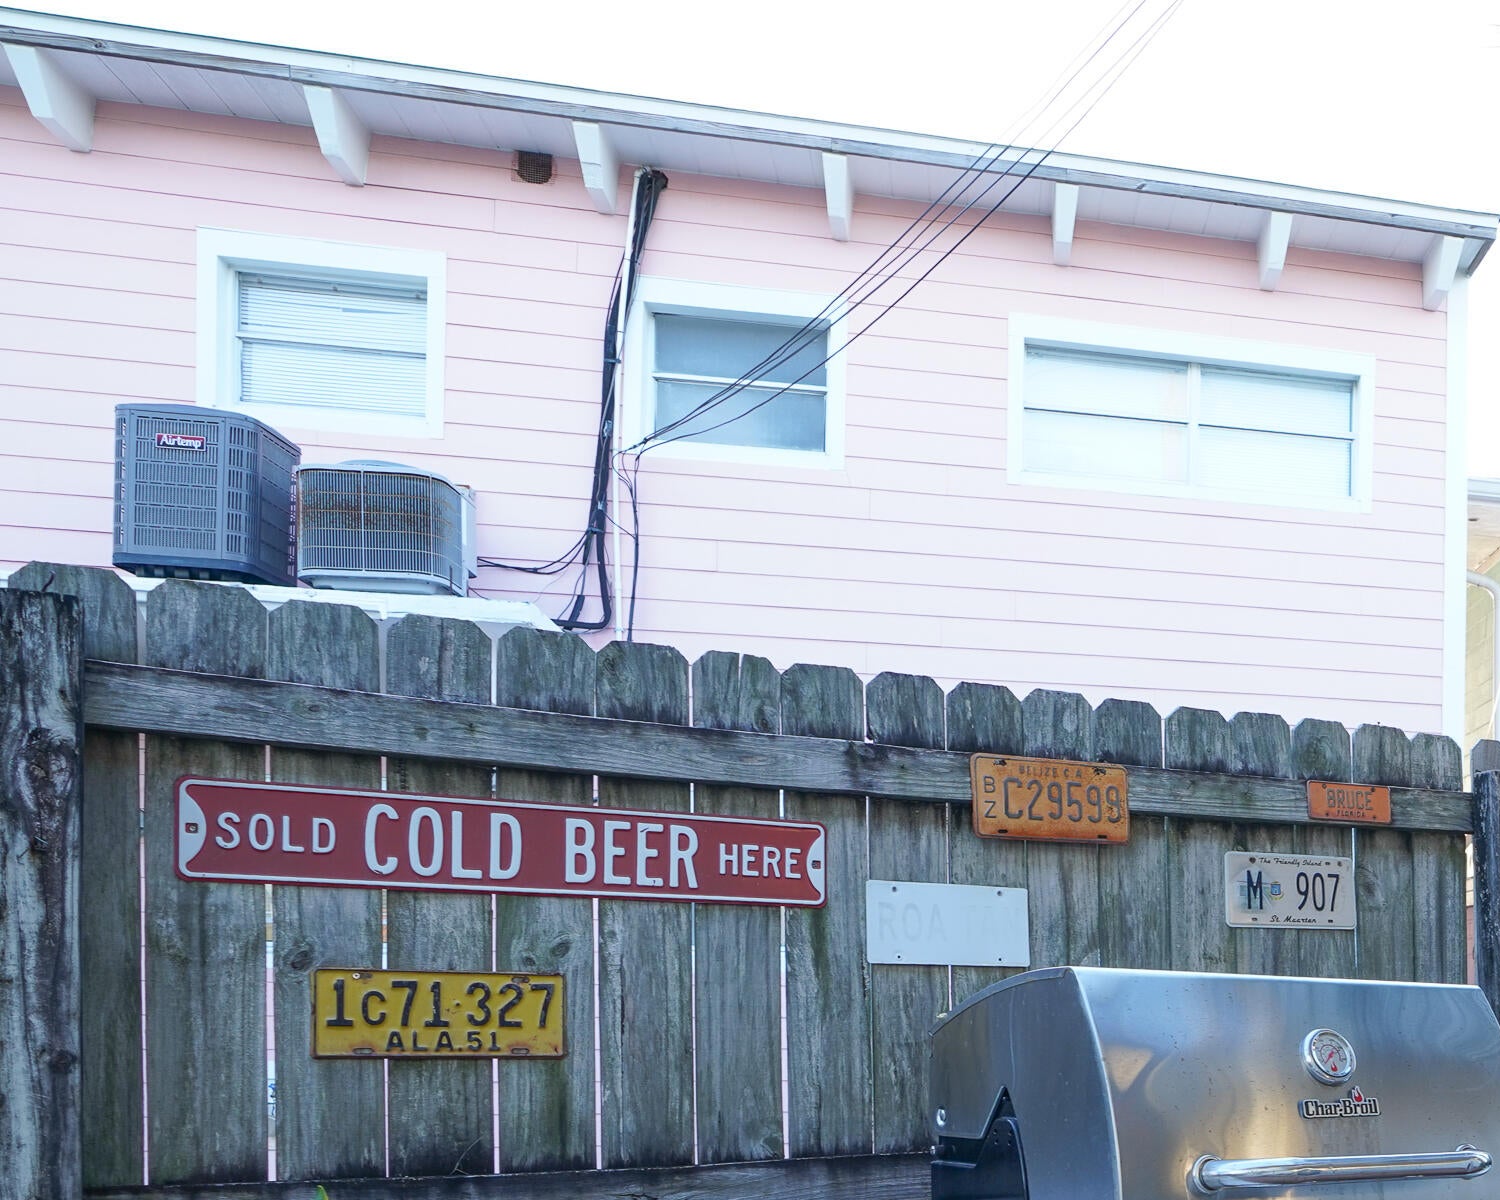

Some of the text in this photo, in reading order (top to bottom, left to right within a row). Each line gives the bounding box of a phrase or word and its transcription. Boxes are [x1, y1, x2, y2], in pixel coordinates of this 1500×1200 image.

[160, 435, 201, 449] Airtemp
[1003, 776, 1121, 823] C29599
[1327, 788, 1374, 811] BRUCE
[1336, 809, 1366, 817] FLORIDA
[215, 803, 802, 889] SOLD COLD BEER HERE
[1246, 870, 1340, 912] M 907
